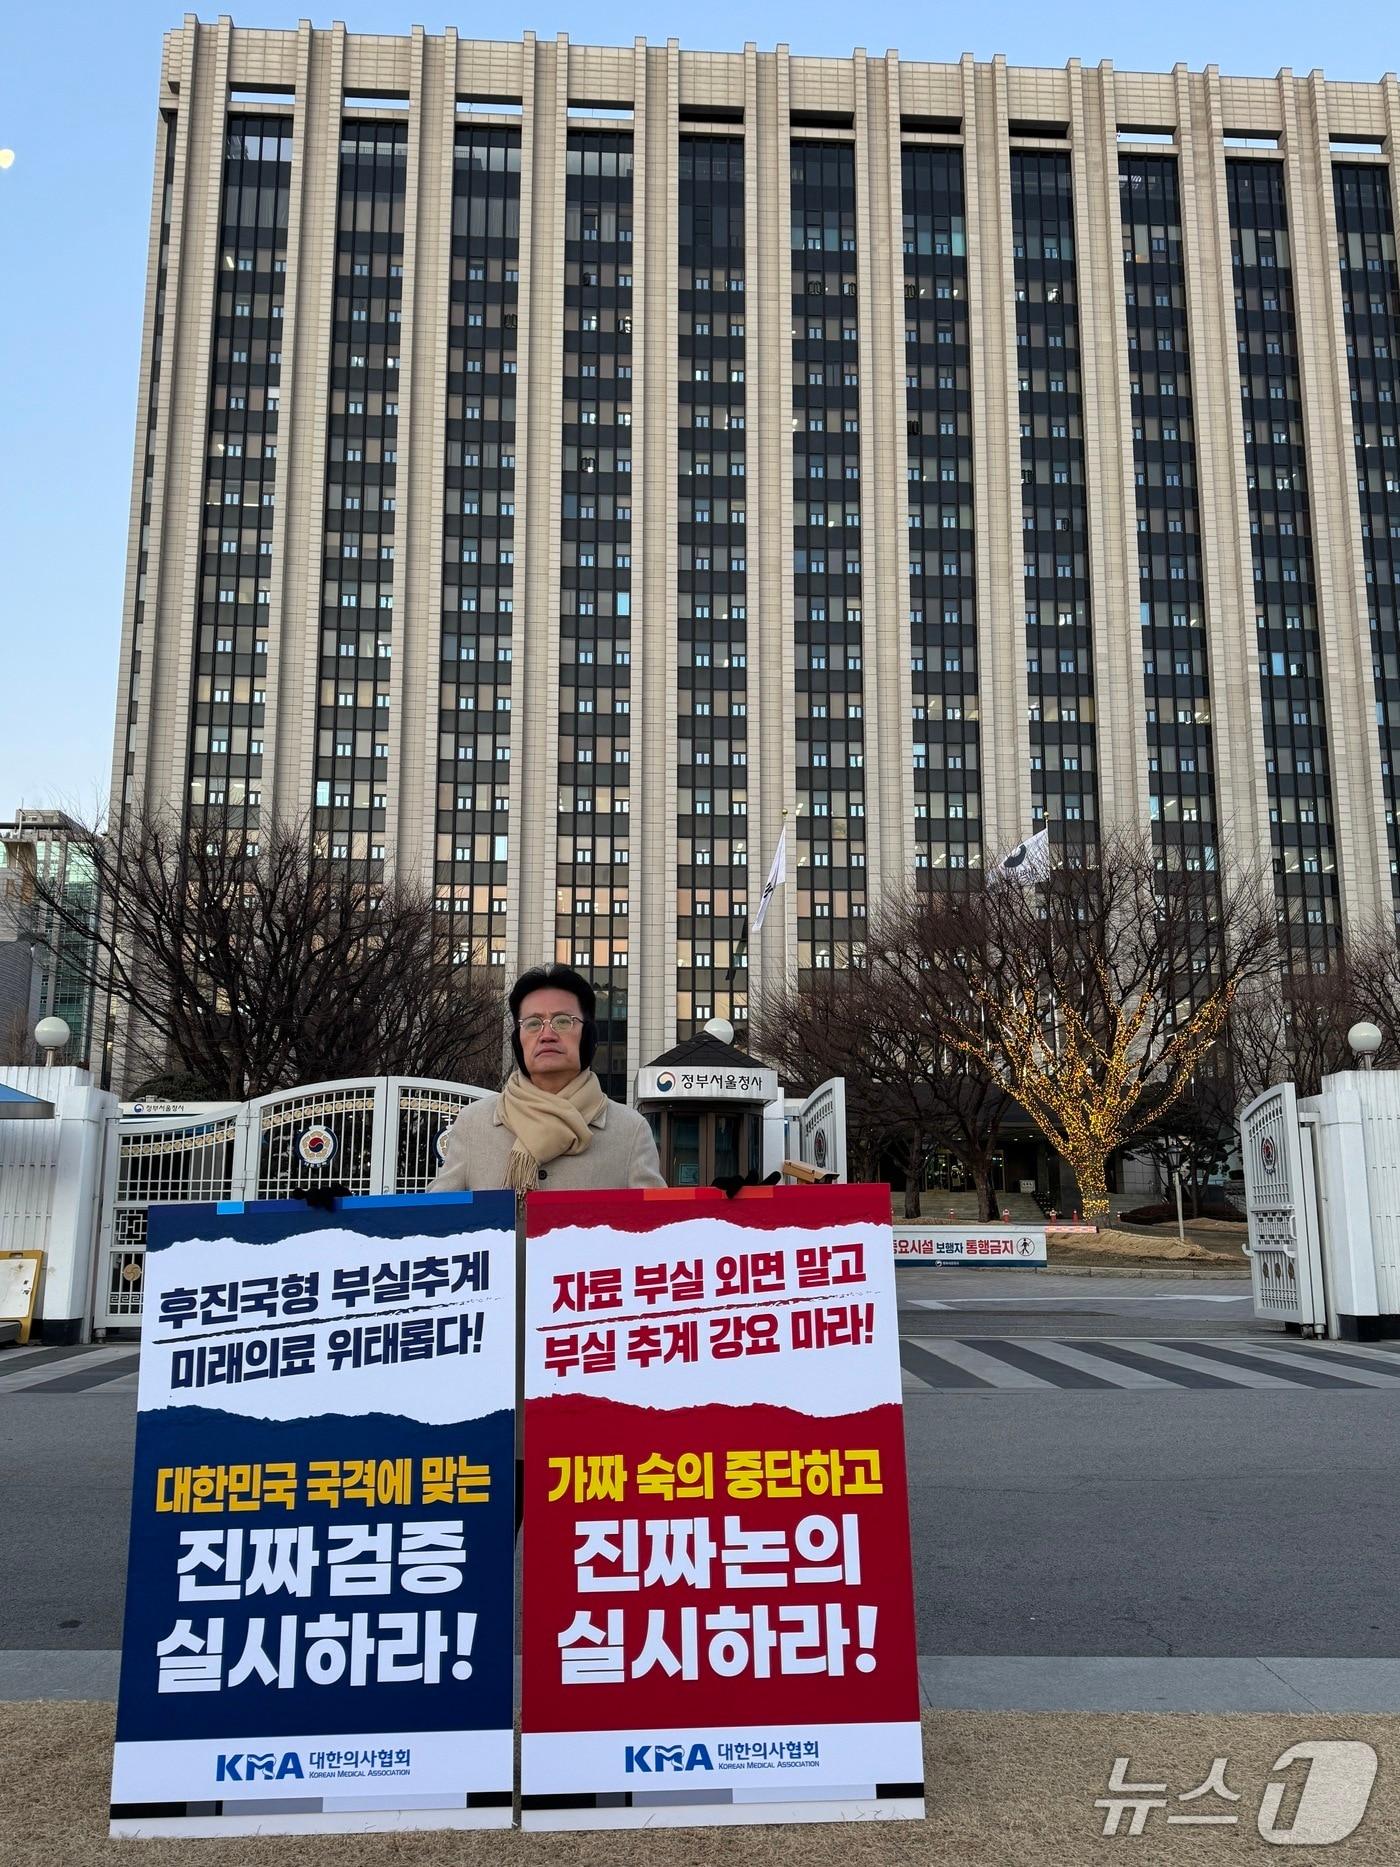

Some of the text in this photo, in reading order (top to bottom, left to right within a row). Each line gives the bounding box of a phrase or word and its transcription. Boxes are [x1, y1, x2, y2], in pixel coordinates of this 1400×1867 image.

[681, 1073, 763, 1091] 정부서울청사
[551, 1243, 867, 1314] 자료 부실 외면 말고
[936, 1242, 963, 1254] 보행자
[965, 1239, 1014, 1255] 통행금지
[158, 1250, 490, 1330] 후진국형 부실추계
[170, 1311, 485, 1390] 미래의료 위태롭다!
[544, 1303, 875, 1378] 부실 추계 강요 마라!
[155, 1455, 492, 1514] 대한민국 국격에 맞는
[547, 1449, 884, 1503] 가짜 숙의 중단하고
[176, 1520, 467, 1602] 진짜검증
[574, 1513, 862, 1593] 진짜논의
[156, 1610, 478, 1694] 실시하라!
[557, 1603, 879, 1685] 실시하라!
[216, 1751, 305, 1782] KMA
[309, 1749, 411, 1769] 대한의사협회
[625, 1743, 715, 1773] KMA
[717, 1740, 820, 1761] 대한의사협회
